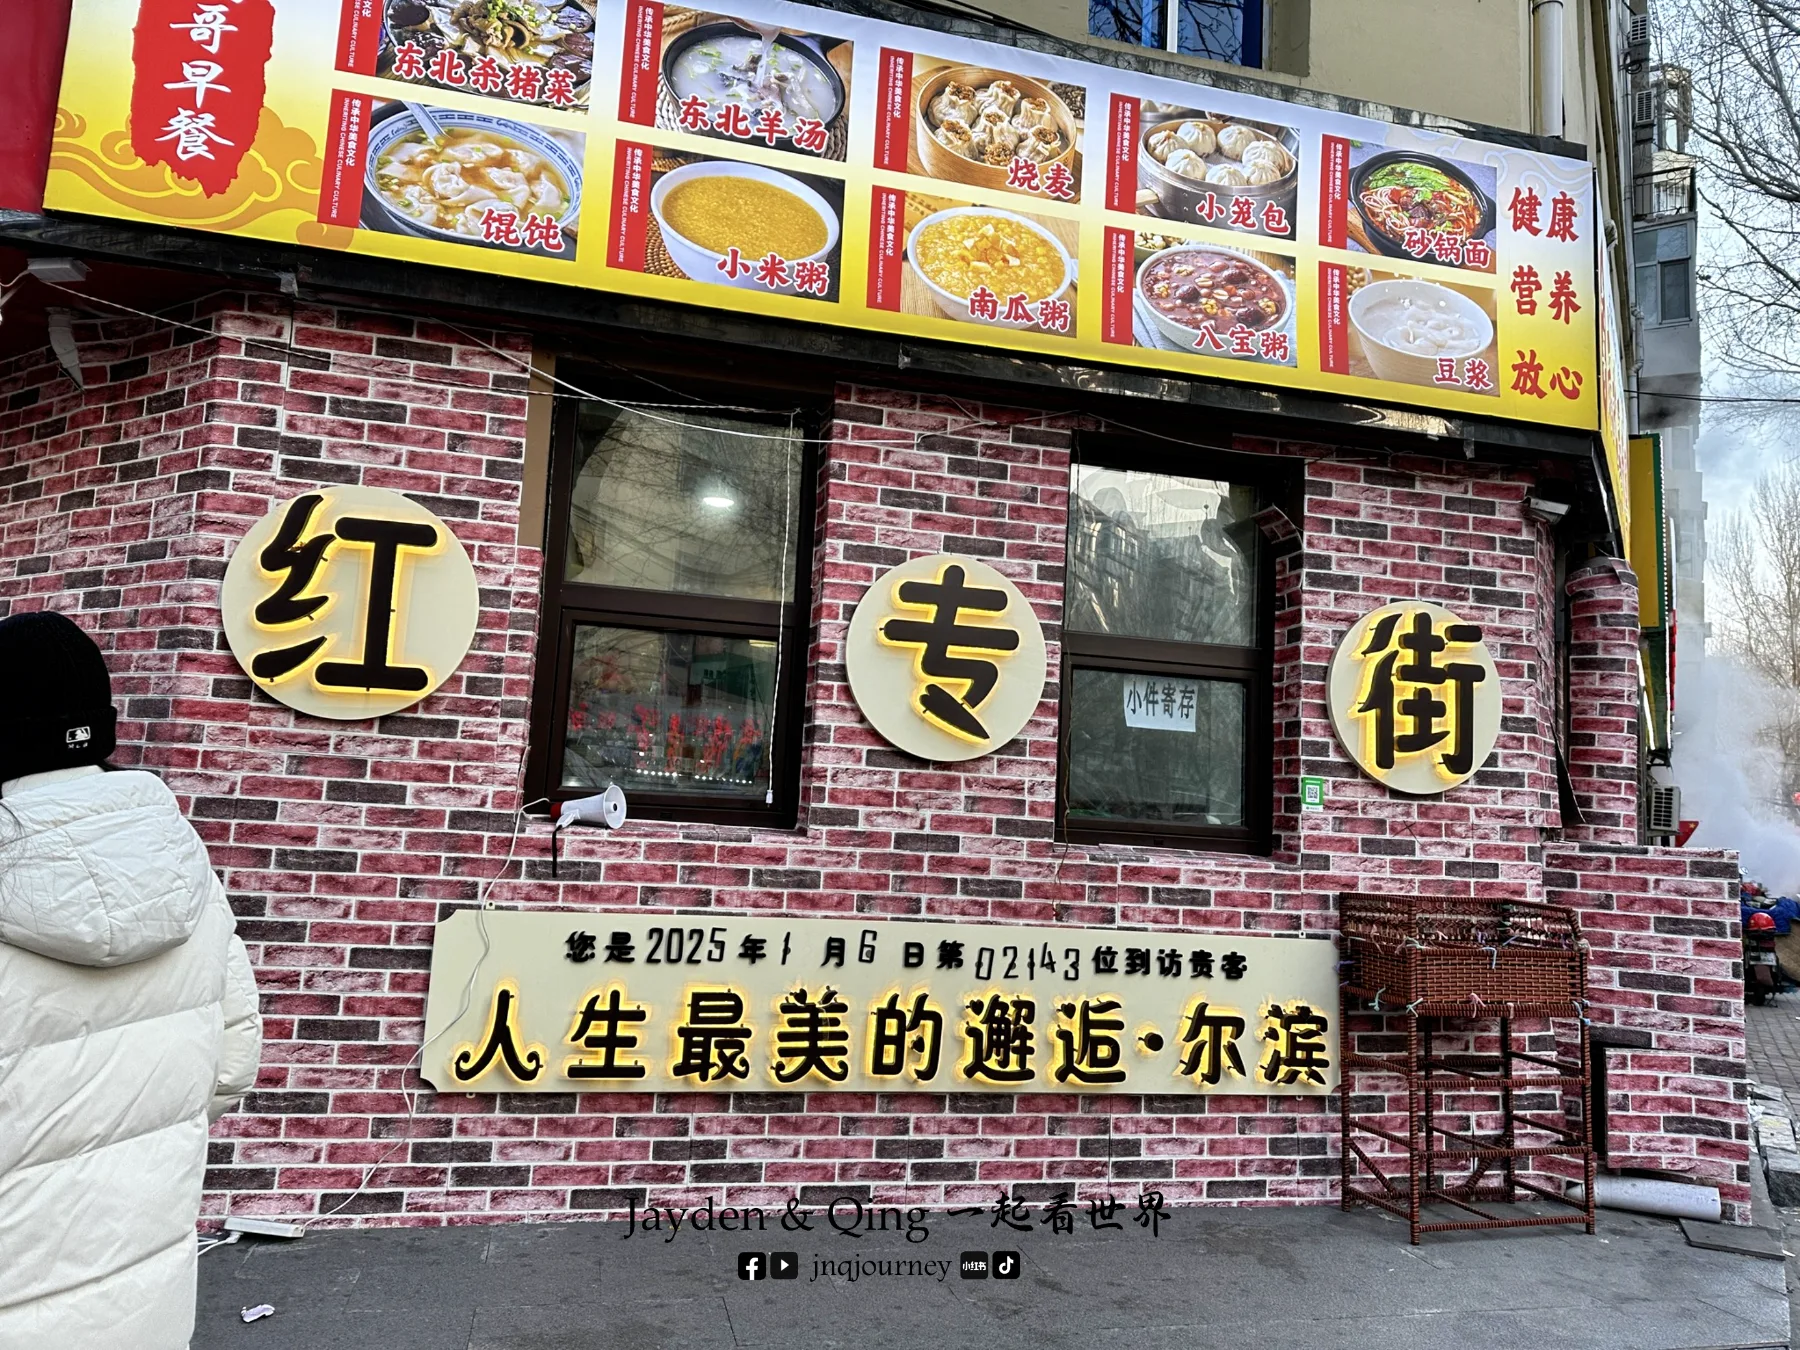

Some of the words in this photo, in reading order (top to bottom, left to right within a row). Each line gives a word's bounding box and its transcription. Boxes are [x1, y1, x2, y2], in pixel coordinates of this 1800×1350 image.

[154, 3, 238, 161] 哥早餐
[394, 40, 577, 104] 东北杀猪菜
[679, 95, 828, 151] 东北羊汤
[1008, 157, 1073, 199] 烧麦
[479, 208, 564, 249] 馄饨
[1196, 192, 1290, 234] 小笼包
[1508, 187, 1579, 242] 健康
[1402, 229, 1491, 267] 砂锅面
[717, 248, 829, 295] 小米粥
[1510, 265, 1581, 324] 营养
[969, 286, 1071, 331] 南瓜粥
[1193, 324, 1289, 360] 八宝粥
[1434, 357, 1492, 389] 豆浆
[1511, 349, 1583, 400] 放心
[252, 494, 438, 691] 红
[884, 564, 1019, 739] 专
[1358, 612, 1486, 774] 街
[1126, 680, 1195, 719] 小件寄存
